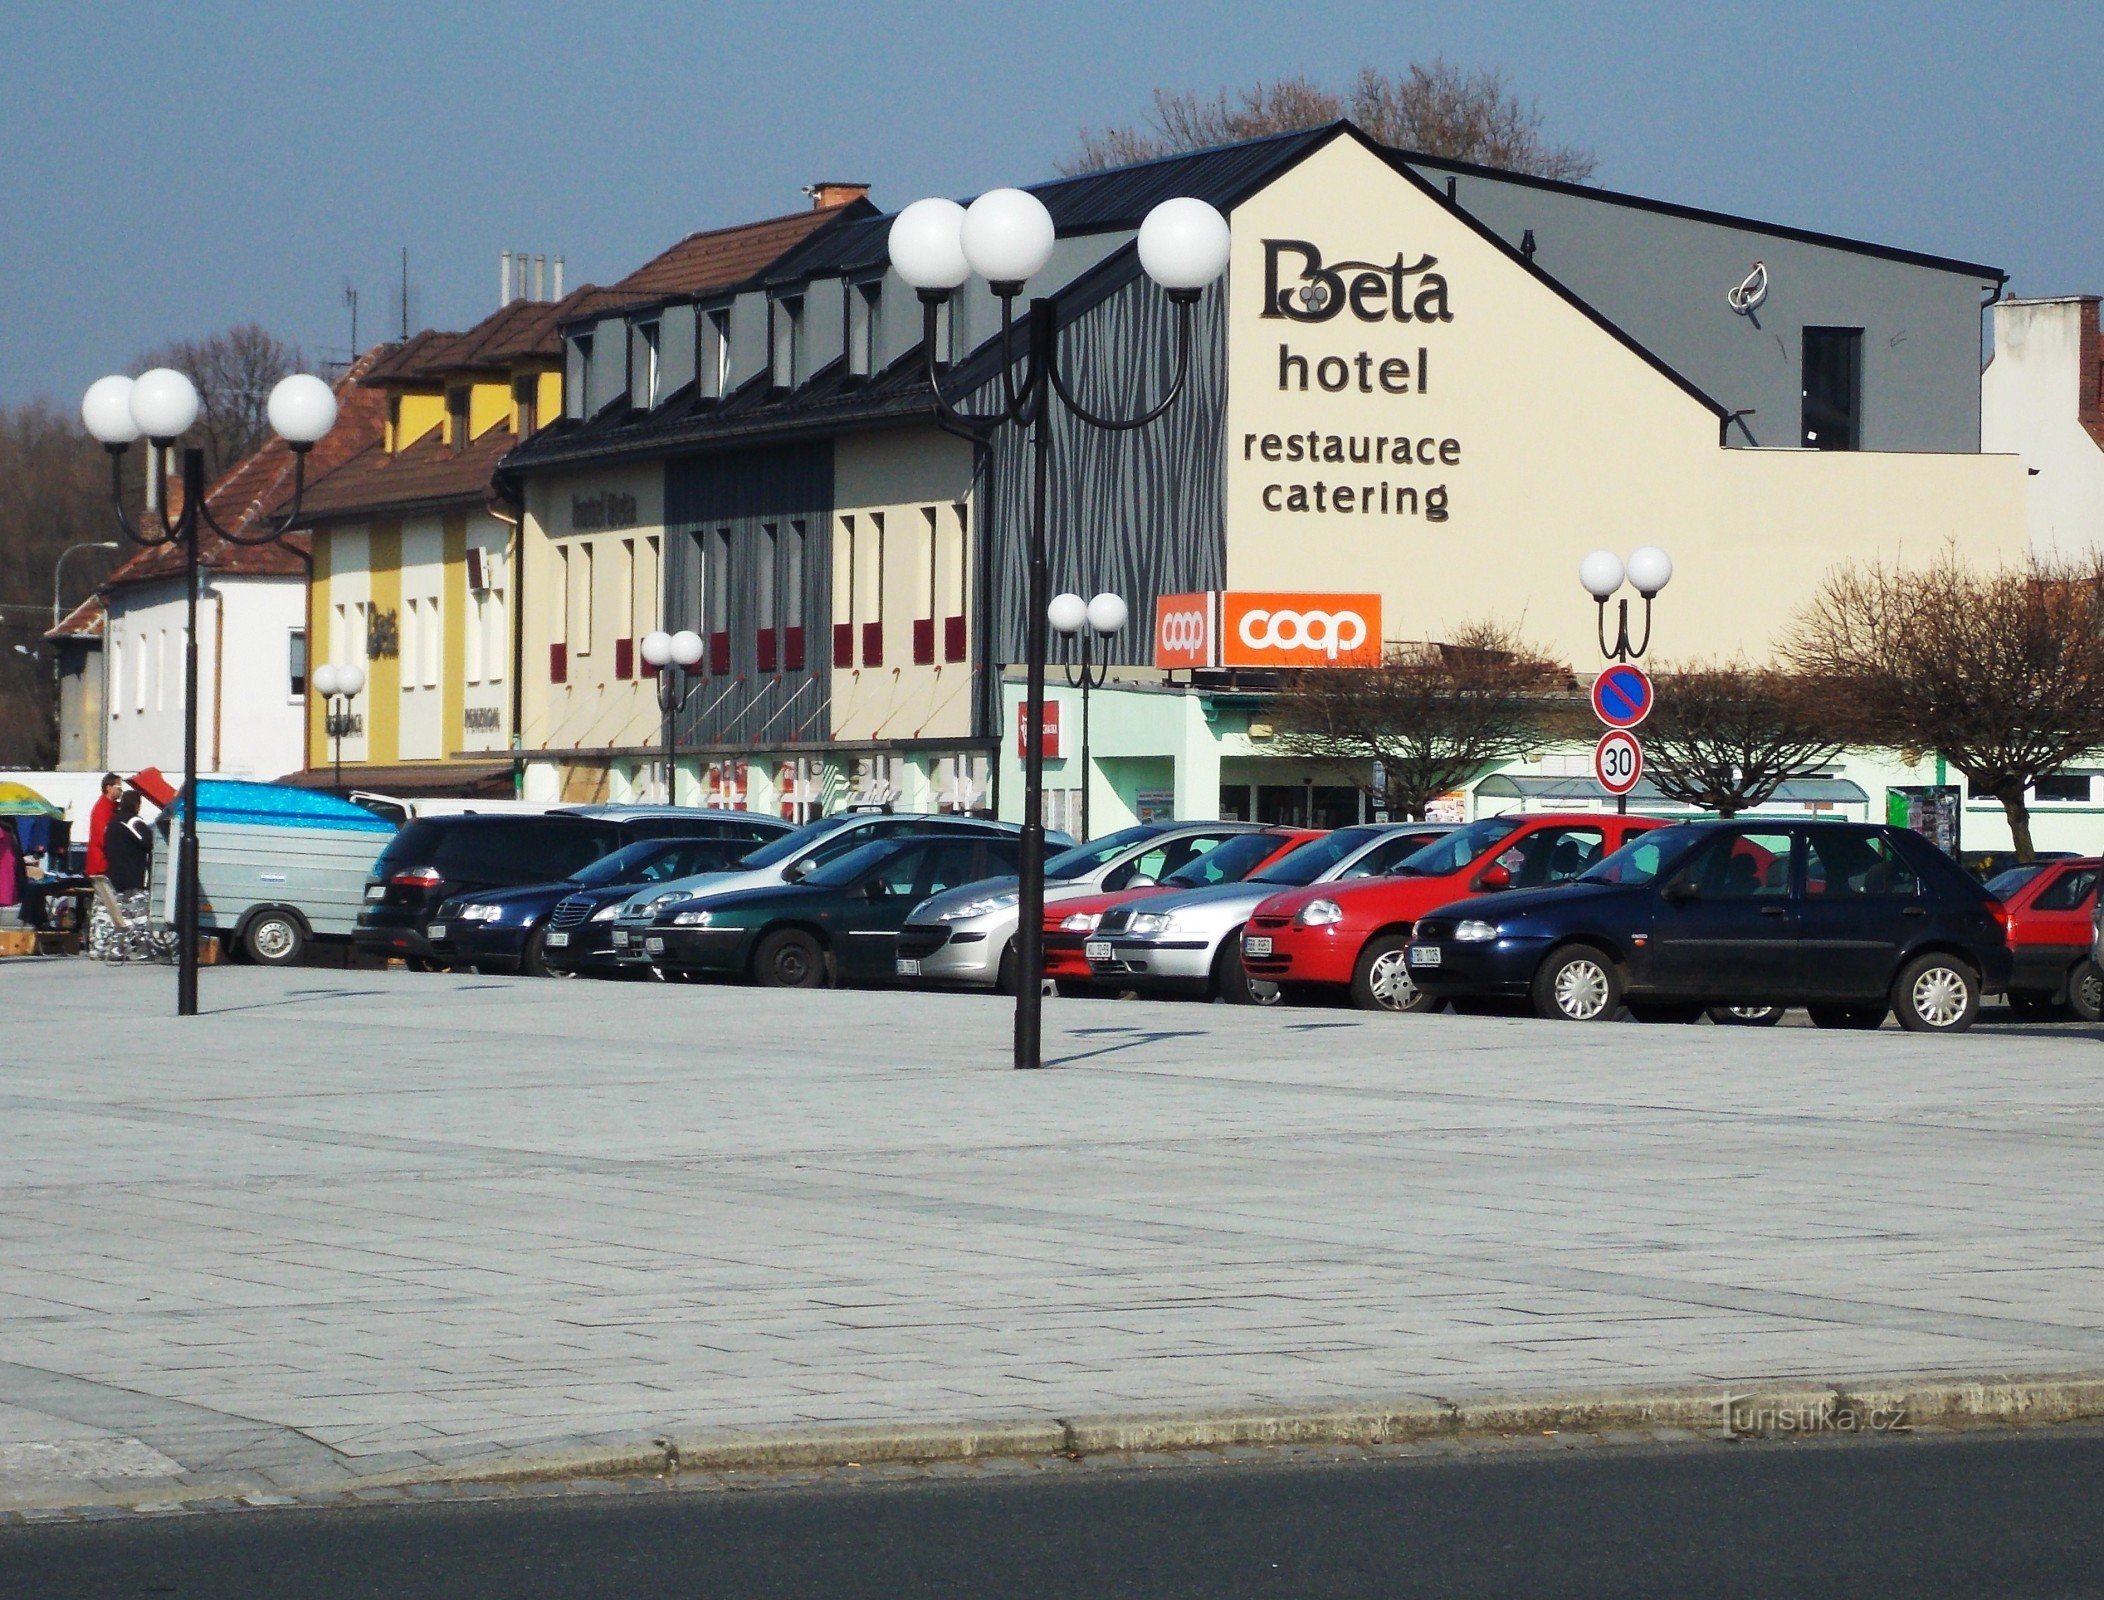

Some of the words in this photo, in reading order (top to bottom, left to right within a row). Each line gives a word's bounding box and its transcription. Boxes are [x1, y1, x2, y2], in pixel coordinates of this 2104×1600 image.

[1278, 344, 1428, 394] hotel
[1244, 430, 1462, 466] restaurace
[1262, 480, 1450, 521] catering
[1161, 610, 1204, 661] coop
[1239, 609, 1367, 659] coop
[1605, 747, 1632, 777] 30
